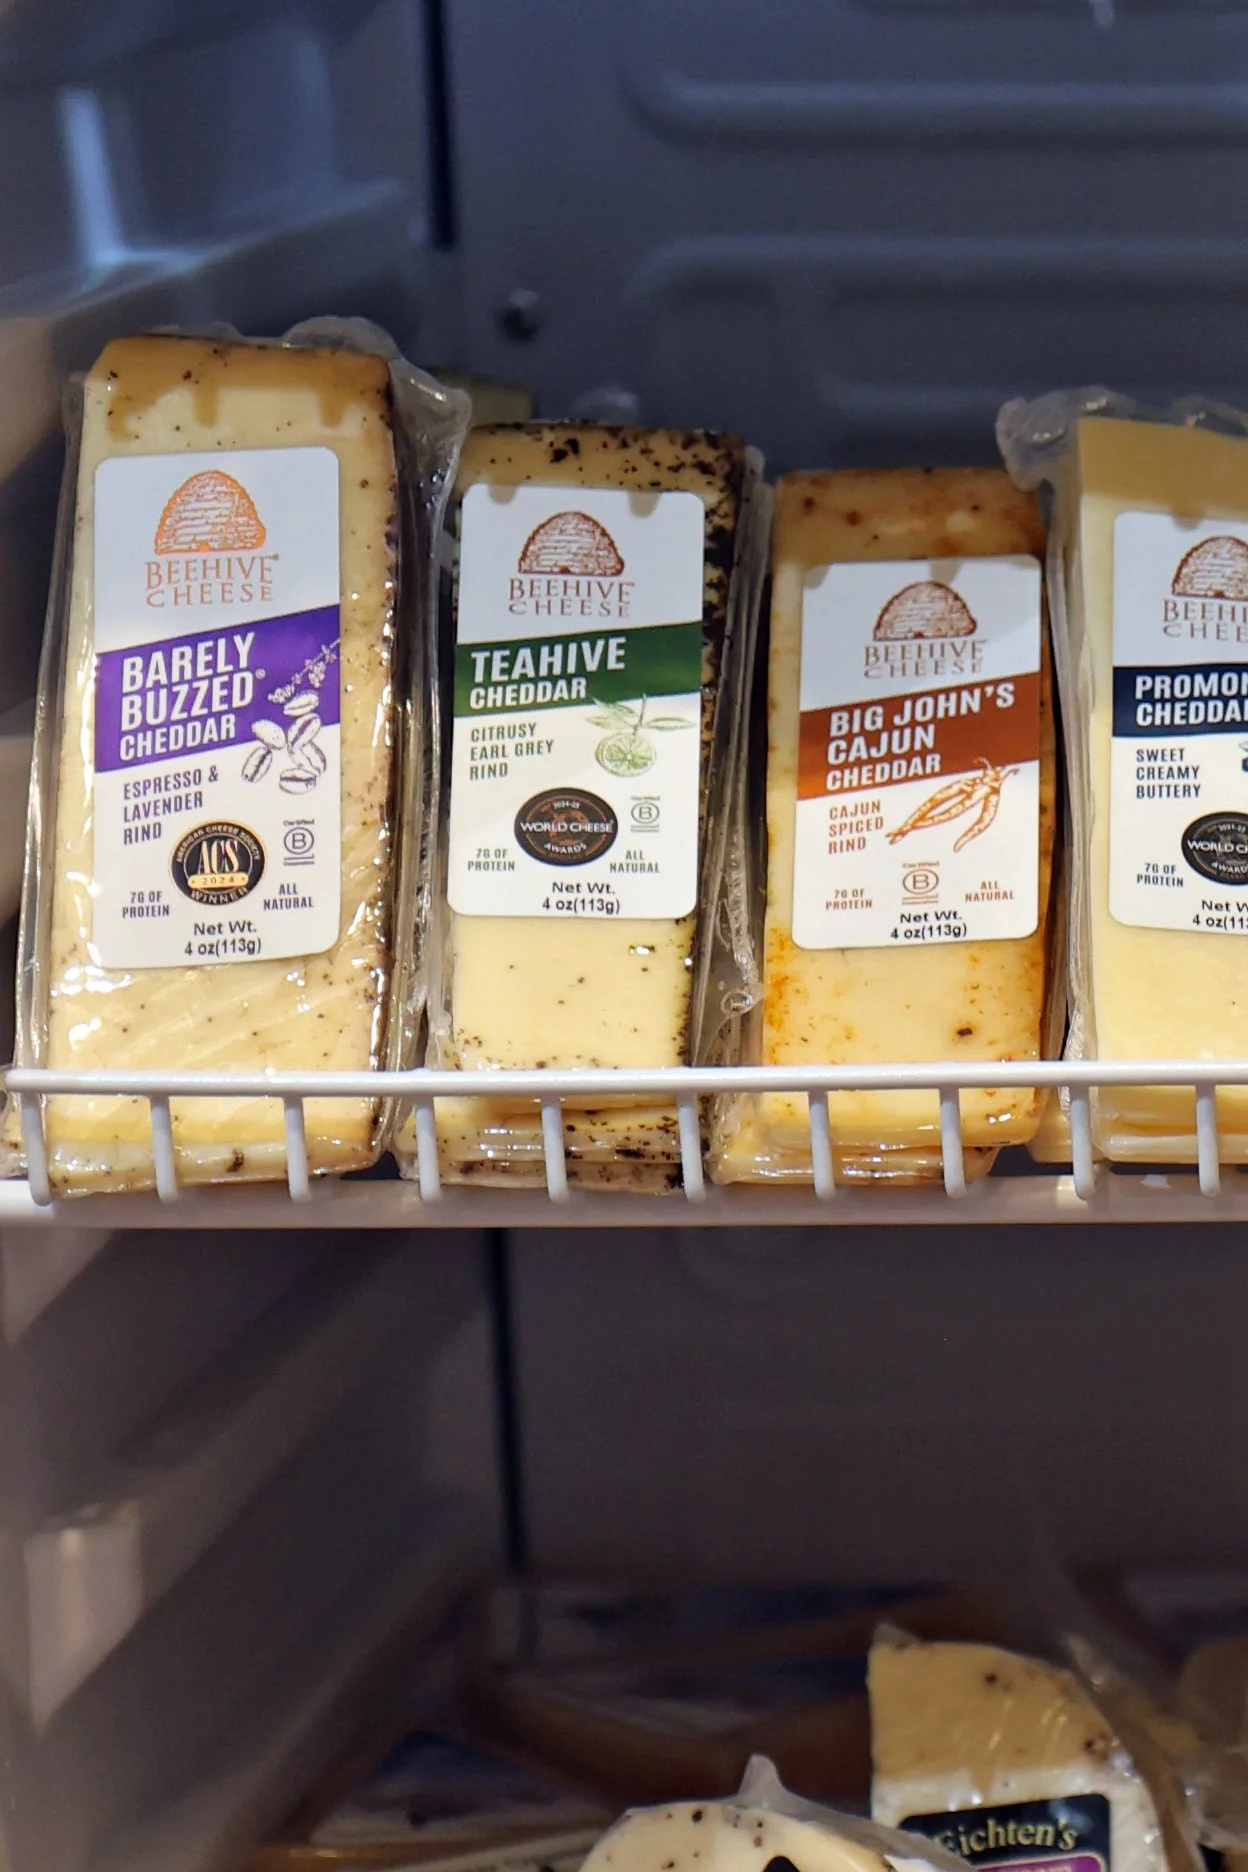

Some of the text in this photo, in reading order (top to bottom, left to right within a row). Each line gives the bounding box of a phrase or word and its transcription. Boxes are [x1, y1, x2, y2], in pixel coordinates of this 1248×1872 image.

[145, 555, 274, 591] BEEHIVE
[146, 582, 273, 607] CHEESE
[509, 578, 632, 604] BEEHIVE
[509, 599, 630, 617] CHEESE
[471, 637, 627, 684] TEAHIVE
[864, 639, 987, 667] BEEHIVE
[122, 632, 256, 695] BARELY
[864, 659, 983, 679] CHEESE
[469, 677, 586, 710] CHEDDAR
[829, 682, 1016, 737] BIG JOHN'S
[120, 714, 236, 762] CHEDDAR
[471, 722, 537, 743] CITRUSY
[470, 740, 554, 761] EARL GREY
[827, 723, 936, 766] CAJUN
[1136, 747, 1185, 763] SWEET
[470, 762, 508, 781] RIND
[826, 752, 941, 792] CHEDDAR
[1136, 765, 1201, 781] CREAMY
[123, 766, 219, 800] ESPRESSO &
[1136, 784, 1201, 800] BUTTERY
[123, 792, 204, 822] LAVENDER
[829, 800, 881, 819] CAJUN
[123, 822, 162, 845] RIND
[520, 821, 613, 833] WORLD CHEESE
[828, 817, 884, 838] SPICED
[544, 842, 588, 854] AWARDS
[828, 837, 867, 855] RIND
[1187, 840, 1235, 852] WORLD
[197, 840, 239, 874] ACS
[202, 877, 235, 885] 2024
[279, 883, 297, 895] ALL
[552, 882, 616, 894] Net Wt.
[146, 890, 162, 903] OF
[191, 887, 248, 903] WINNER
[264, 897, 313, 911] NATURAL
[122, 904, 170, 918] PROTEIN
[542, 899, 620, 915] 4 oz(113g)
[194, 920, 257, 935] Net Wt.
[185, 938, 262, 958] 4 oz(113g)
